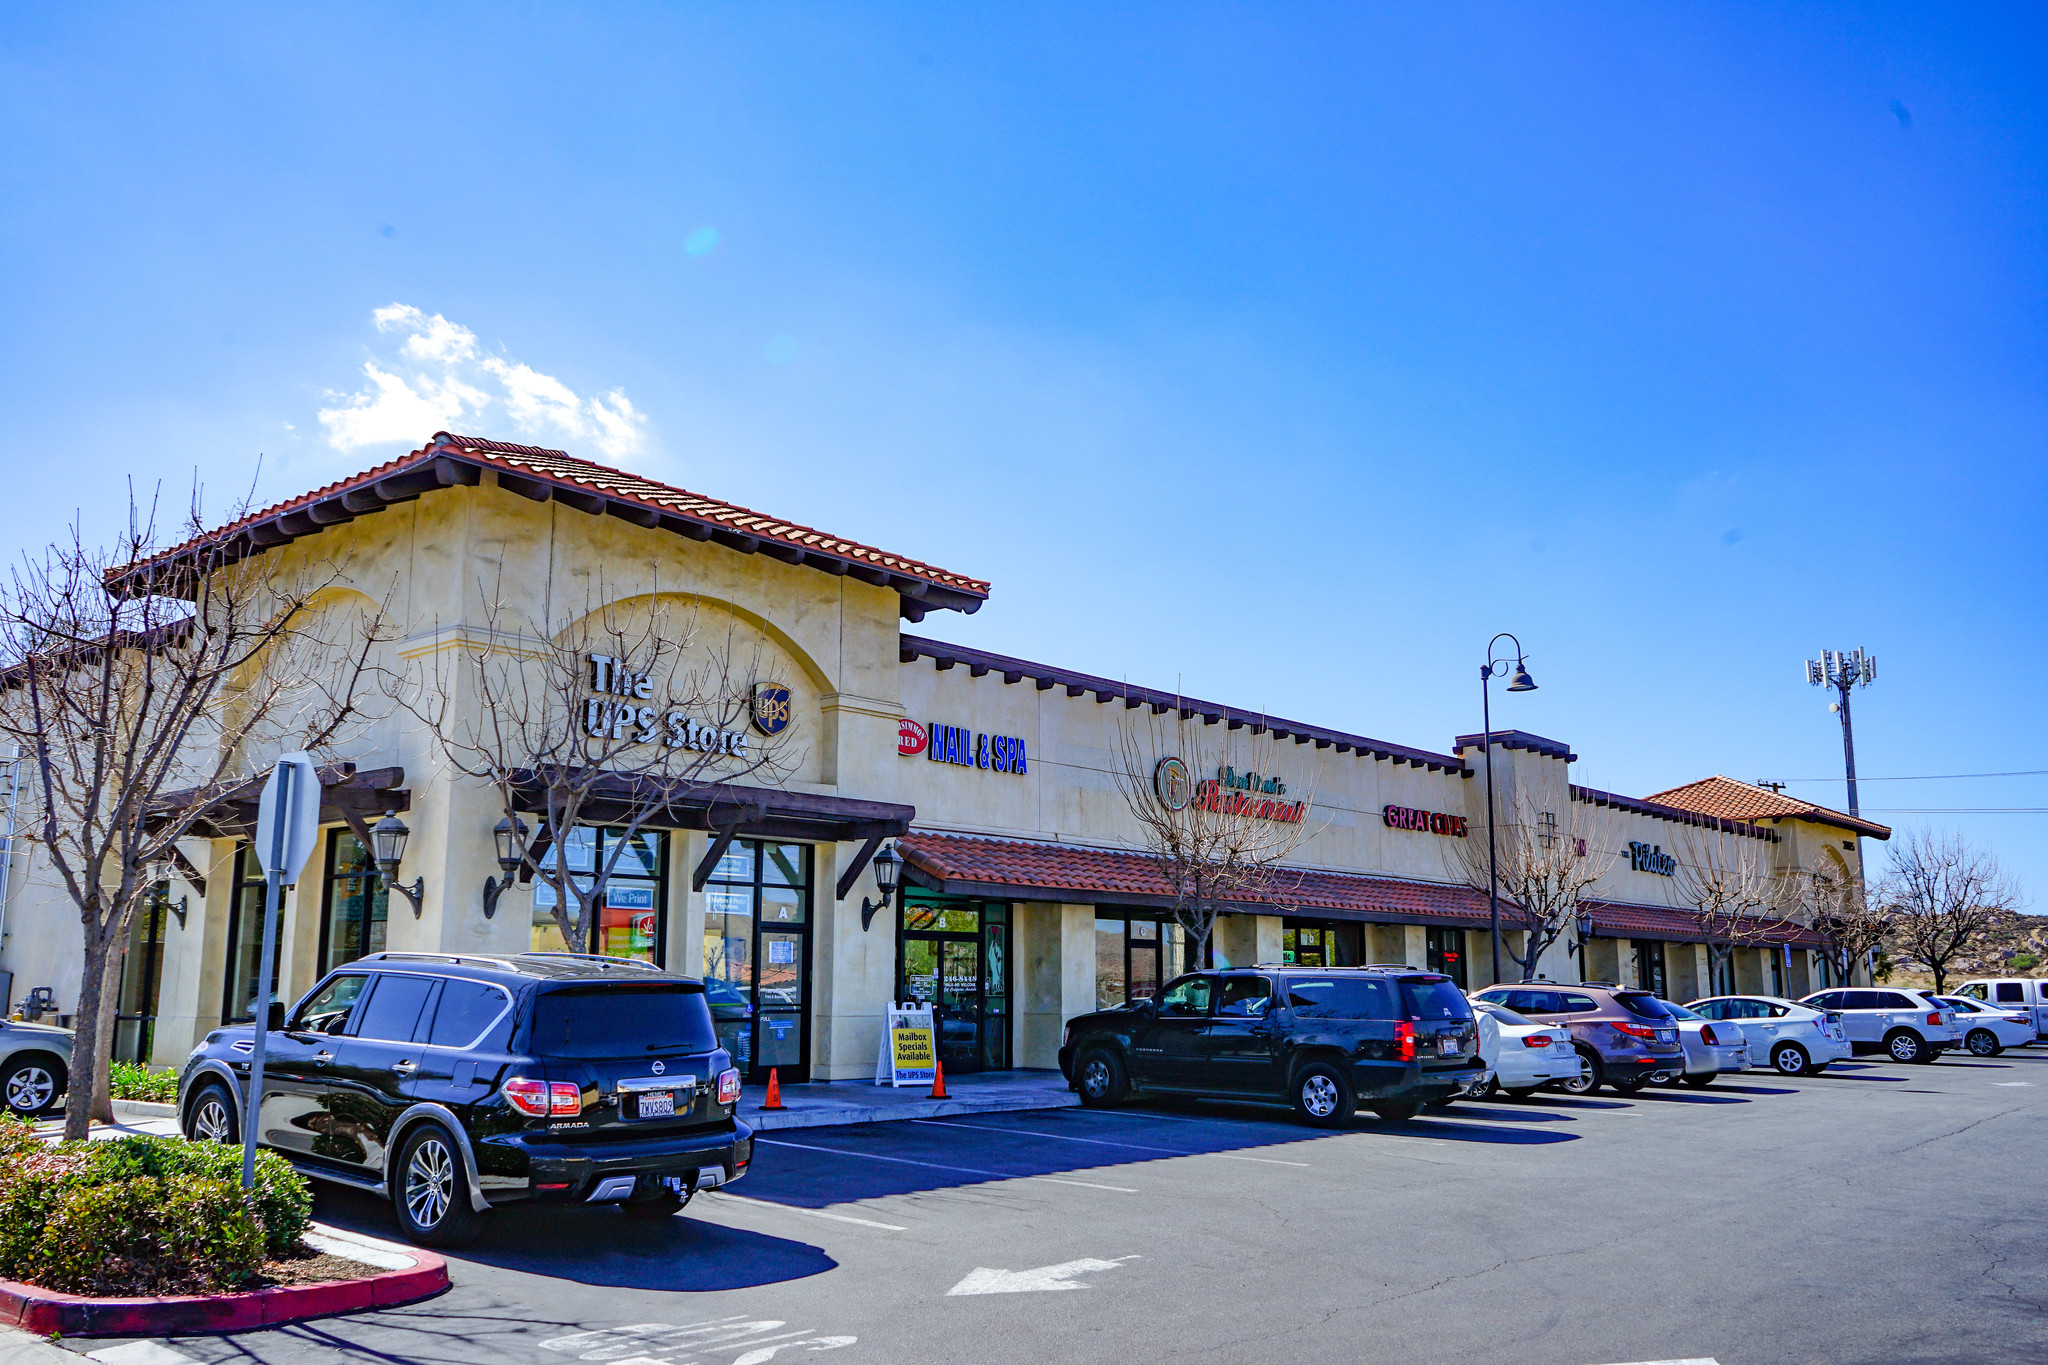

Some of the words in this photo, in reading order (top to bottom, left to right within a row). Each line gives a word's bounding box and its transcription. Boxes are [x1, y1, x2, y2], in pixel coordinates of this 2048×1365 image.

[589, 653, 655, 700] The
[758, 697, 788, 728] ups
[586, 699, 657, 744] UPS
[665, 711, 748, 758] Store
[898, 735, 918, 748] RED
[930, 723, 974, 767] NAIL
[977, 733, 990, 769] &
[994, 735, 1028, 775] SPA
[1195, 779, 1305, 823] Restaurant
[1385, 805, 1431, 832] GREAT
[1432, 812, 1469, 838] CLIPS
[613, 893, 627, 903] We
[628, 893, 648, 904] Print
[778, 906, 788, 919] A
[939, 917, 946, 928] B
[898, 1032, 927, 1041] Mailbox
[898, 1042, 928, 1052] Specials
[897, 1052, 931, 1061] Available
[896, 1070, 907, 1079] The
[907, 1071, 919, 1079] UPS
[920, 1071, 935, 1079] Store
[640, 1100, 673, 1115] 7WVS809
[550, 1121, 590, 1130] ARMADA
